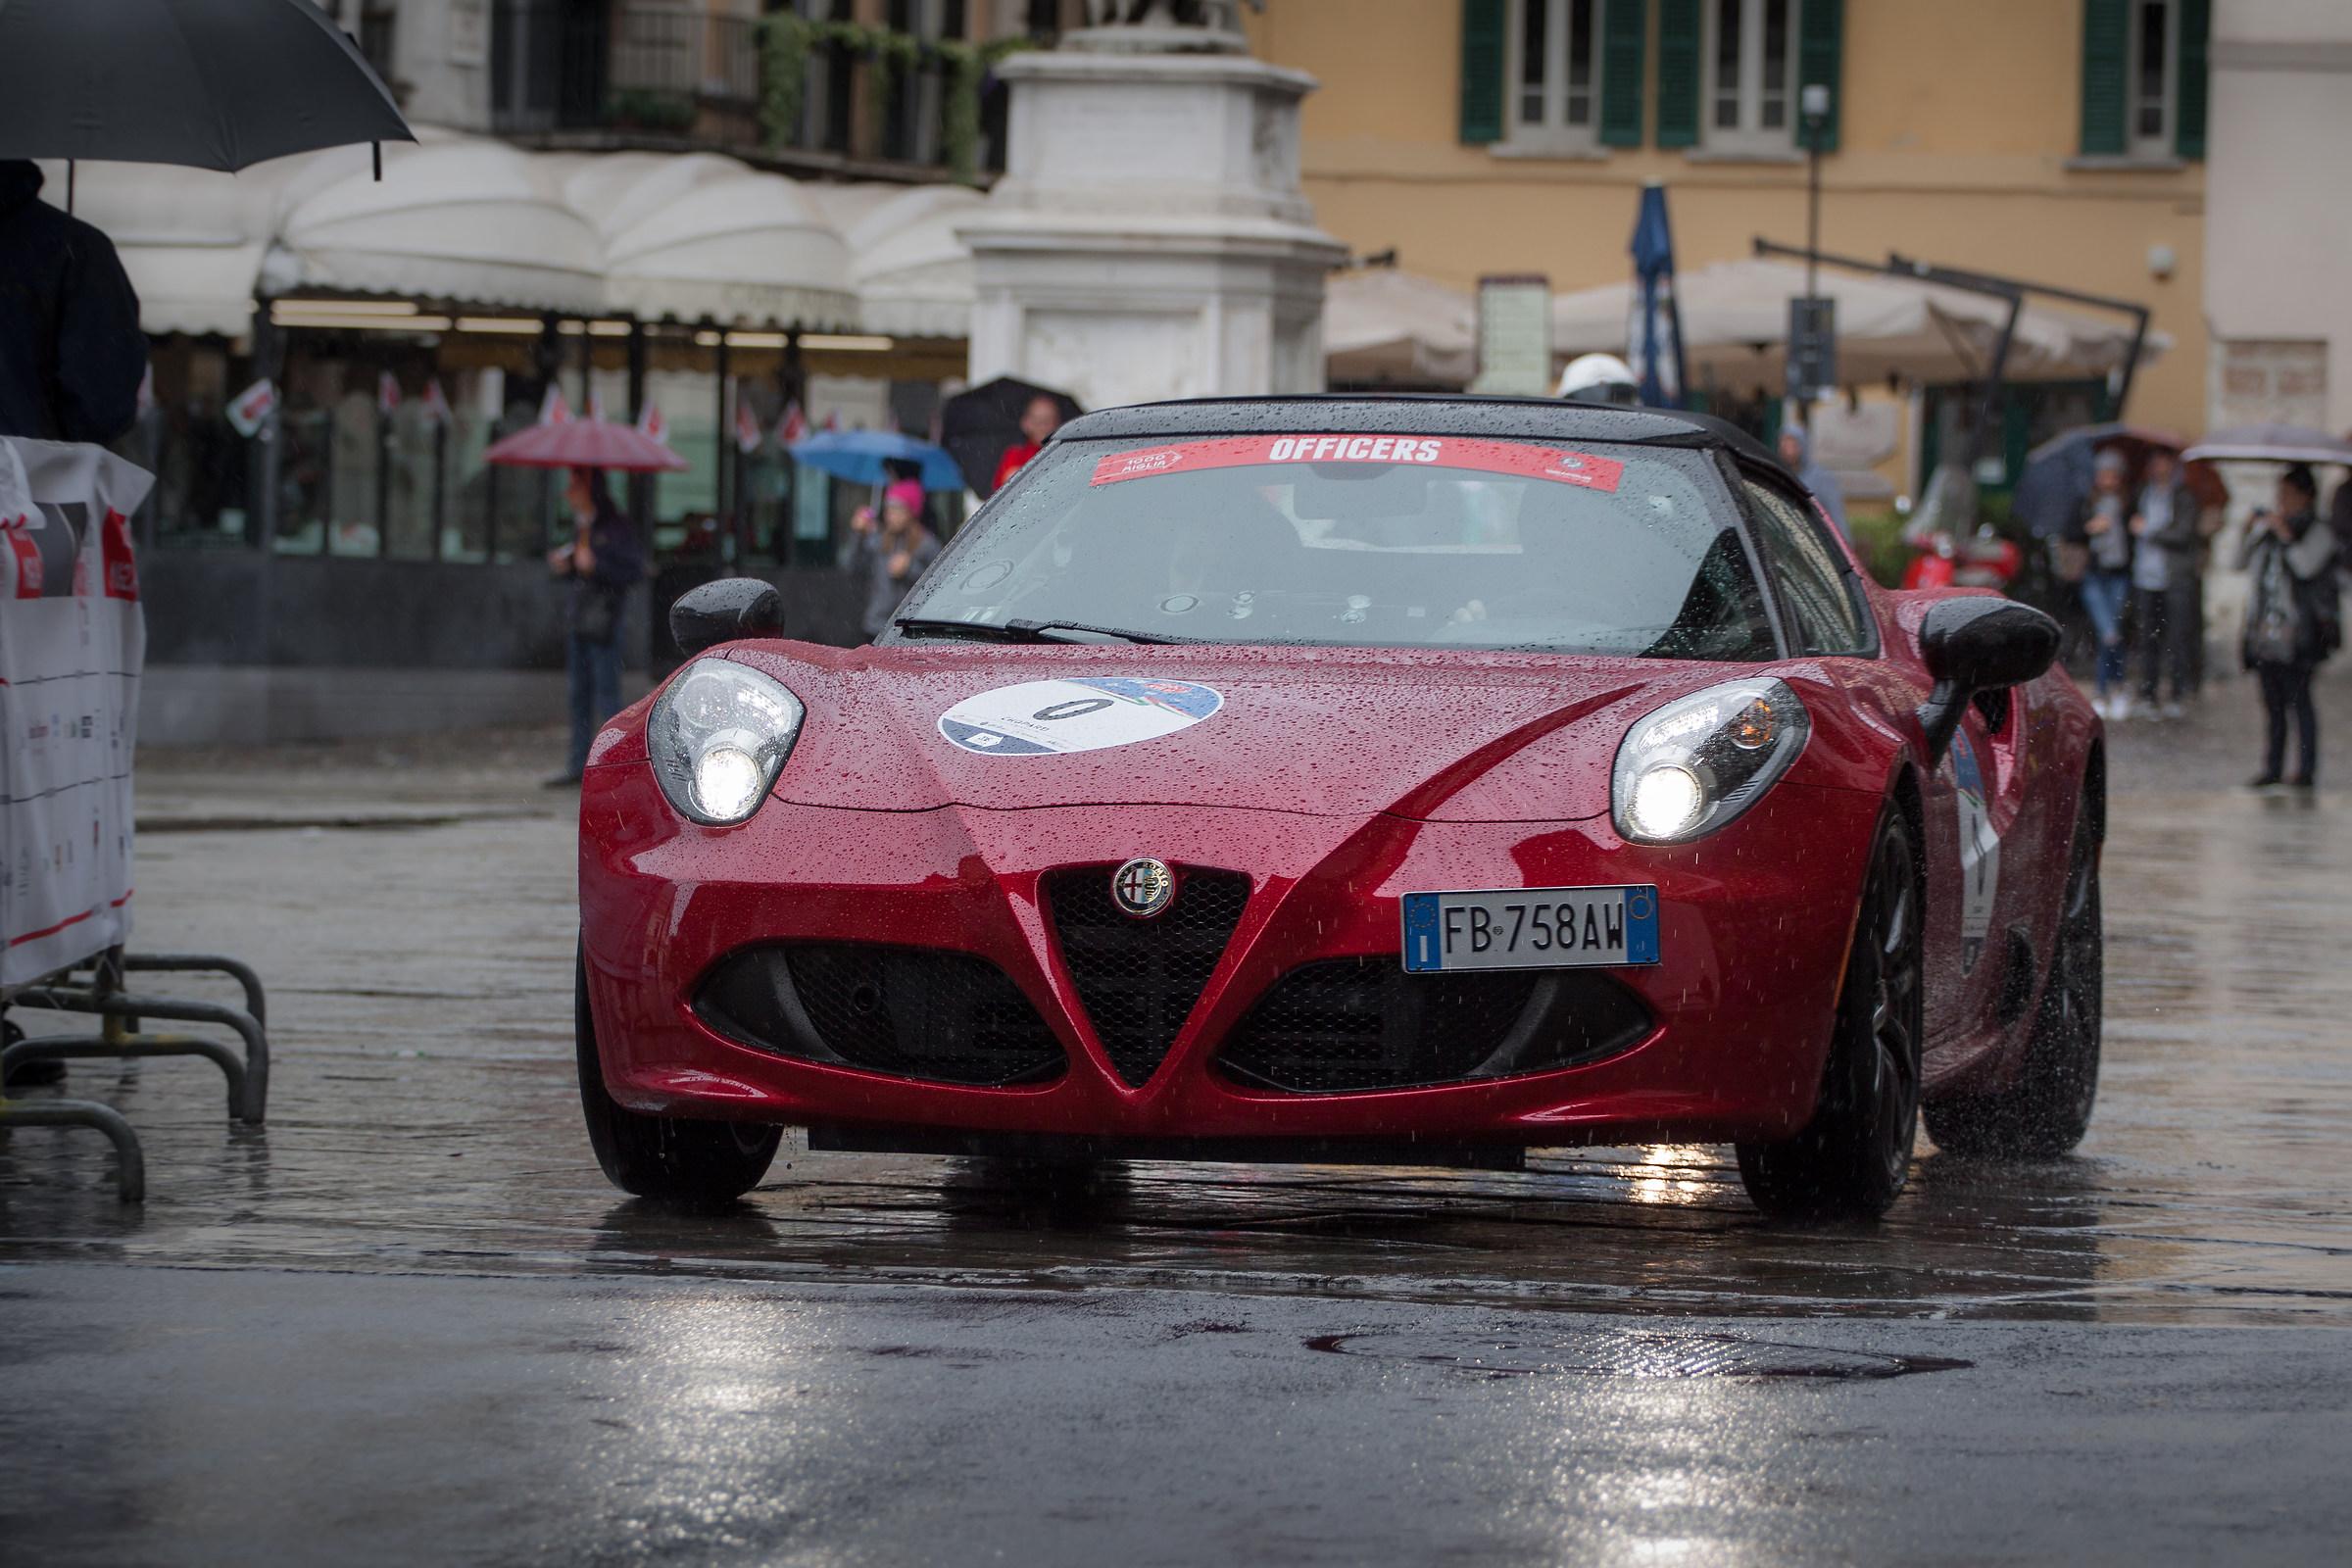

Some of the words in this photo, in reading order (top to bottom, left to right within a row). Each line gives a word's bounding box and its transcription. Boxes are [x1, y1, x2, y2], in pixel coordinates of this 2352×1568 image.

[1268, 437, 1443, 463] OFFICERS
[1121, 460, 1166, 473] MIGLIA
[1128, 453, 1166, 466] 1000
[1032, 698, 1115, 721] 0
